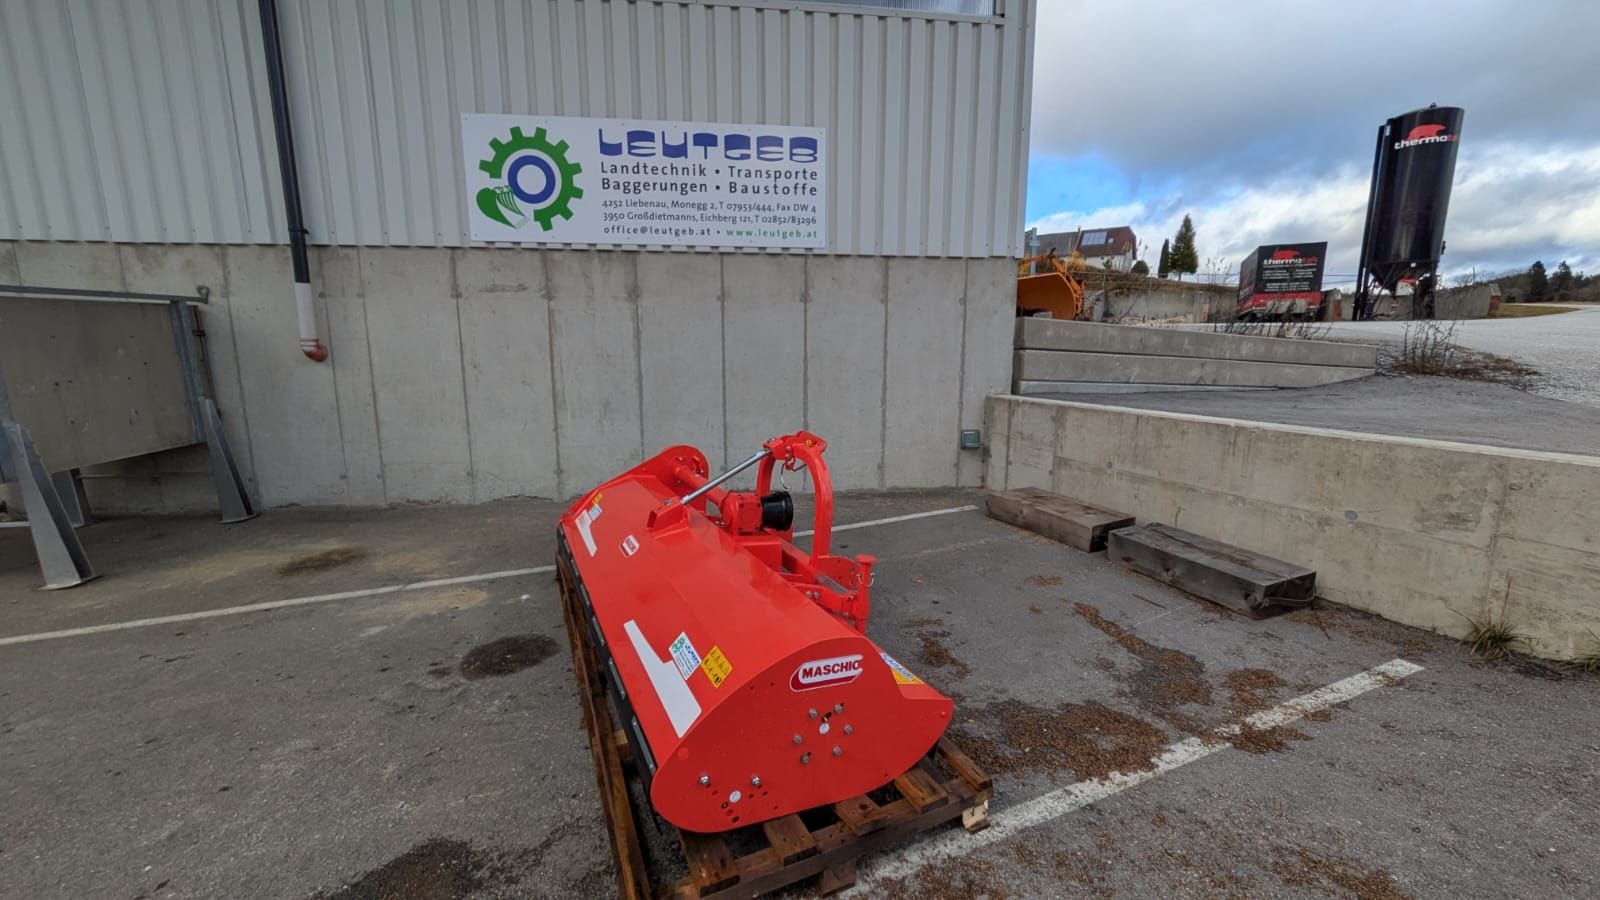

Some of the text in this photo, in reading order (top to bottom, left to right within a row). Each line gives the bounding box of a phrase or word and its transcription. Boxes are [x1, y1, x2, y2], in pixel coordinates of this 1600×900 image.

[599, 128, 818, 163] LEUTGEB
[601, 161, 818, 182] Landtechnik Transporte
[601, 178, 817, 196] Baggerungen Baustoffe
[602, 200, 623, 209] 4252
[625, 199, 670, 210] Liebenau,
[671, 201, 708, 212] Monegg
[726, 203, 775, 213] 07953/444,
[776, 203, 791, 211] Fax
[793, 204, 809, 212] DW
[602, 212, 625, 222] 3950
[626, 211, 699, 223] Großdietmanns,
[700, 213, 737, 224] Eichberg
[603, 225, 817, 239] office@leutgeb.at www.leutgeb.at
